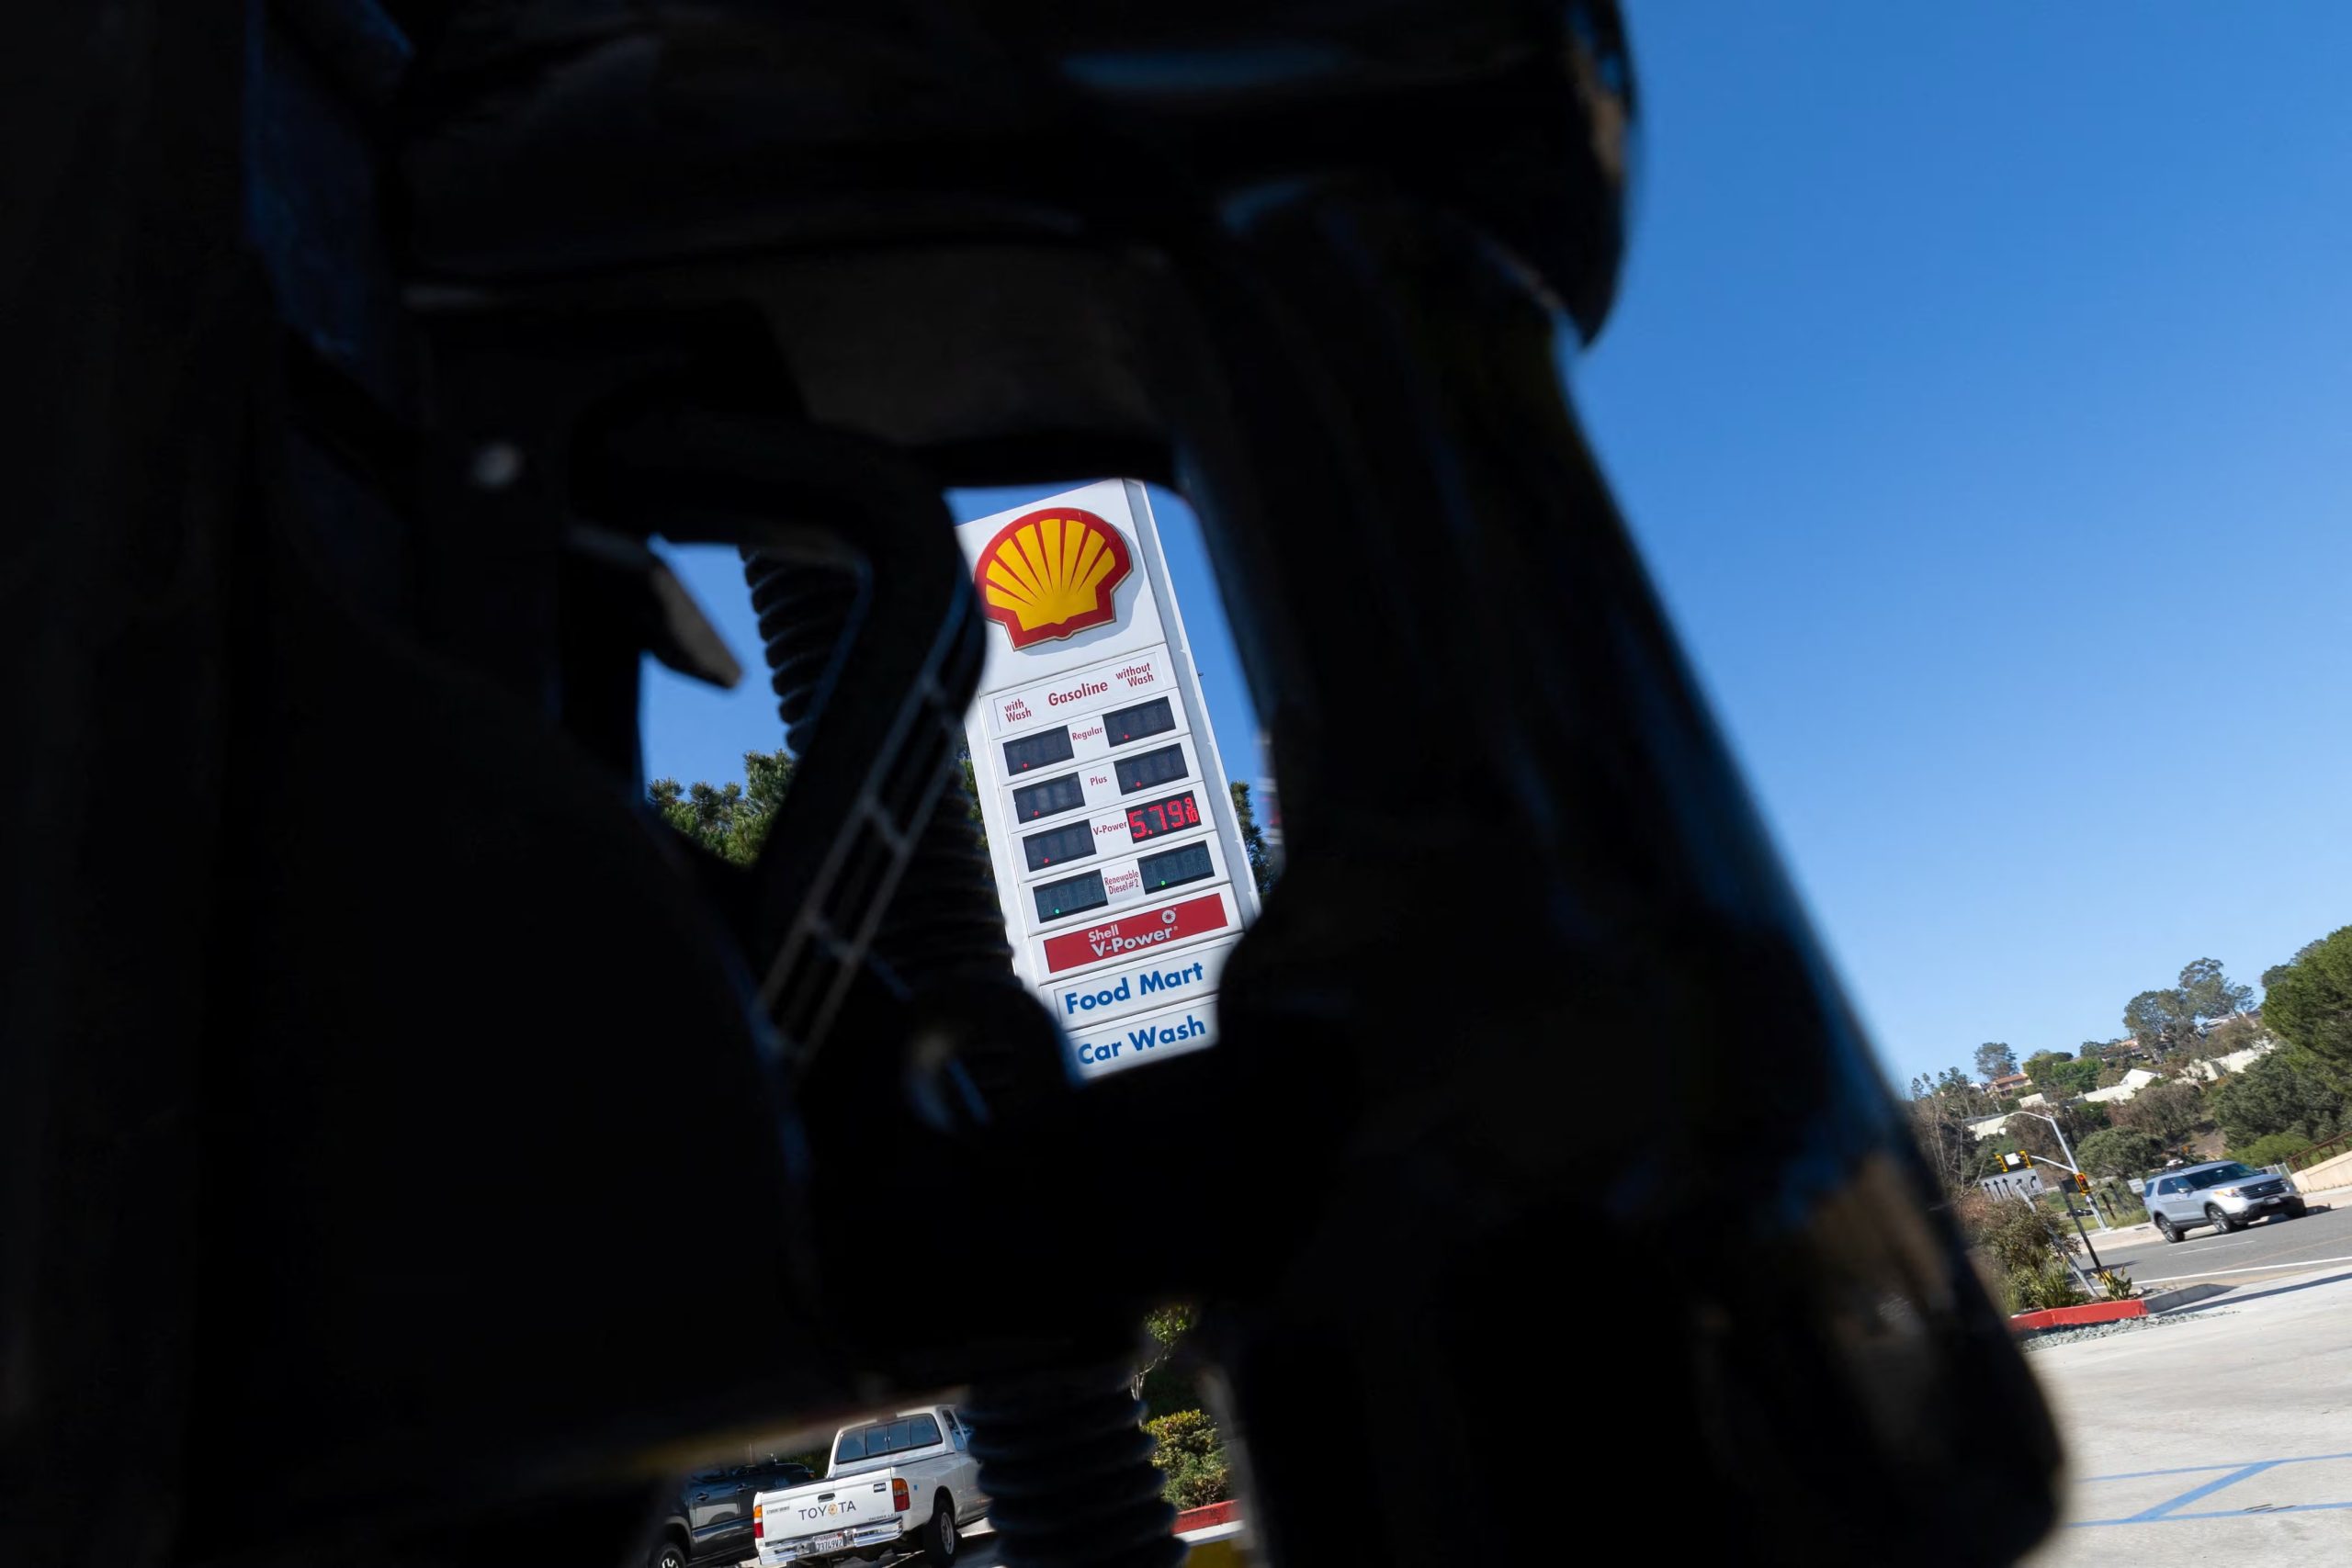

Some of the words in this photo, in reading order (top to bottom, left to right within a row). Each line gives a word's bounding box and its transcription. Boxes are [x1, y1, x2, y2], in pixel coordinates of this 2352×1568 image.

[1115, 662, 1151, 681] without
[1126, 672, 1154, 688] Wash
[1048, 682, 1108, 706] Gasoline
[1004, 699, 1024, 713] with
[1005, 708, 1032, 723] Wash
[1072, 727, 1102, 740] Regular
[1090, 775, 1108, 786] Plus
[1092, 819, 1127, 836] V-Power
[1103, 870, 1139, 886] Renewable
[1088, 924, 1120, 942] Shell
[1091, 928, 1173, 957] V-Power
[1065, 976, 1131, 1015] Food
[1139, 962, 1204, 996] Mart
[1078, 1040, 1122, 1065] Car
[1128, 1015, 1206, 1052] Wash
[798, 1500, 856, 1520] TOYOTA
